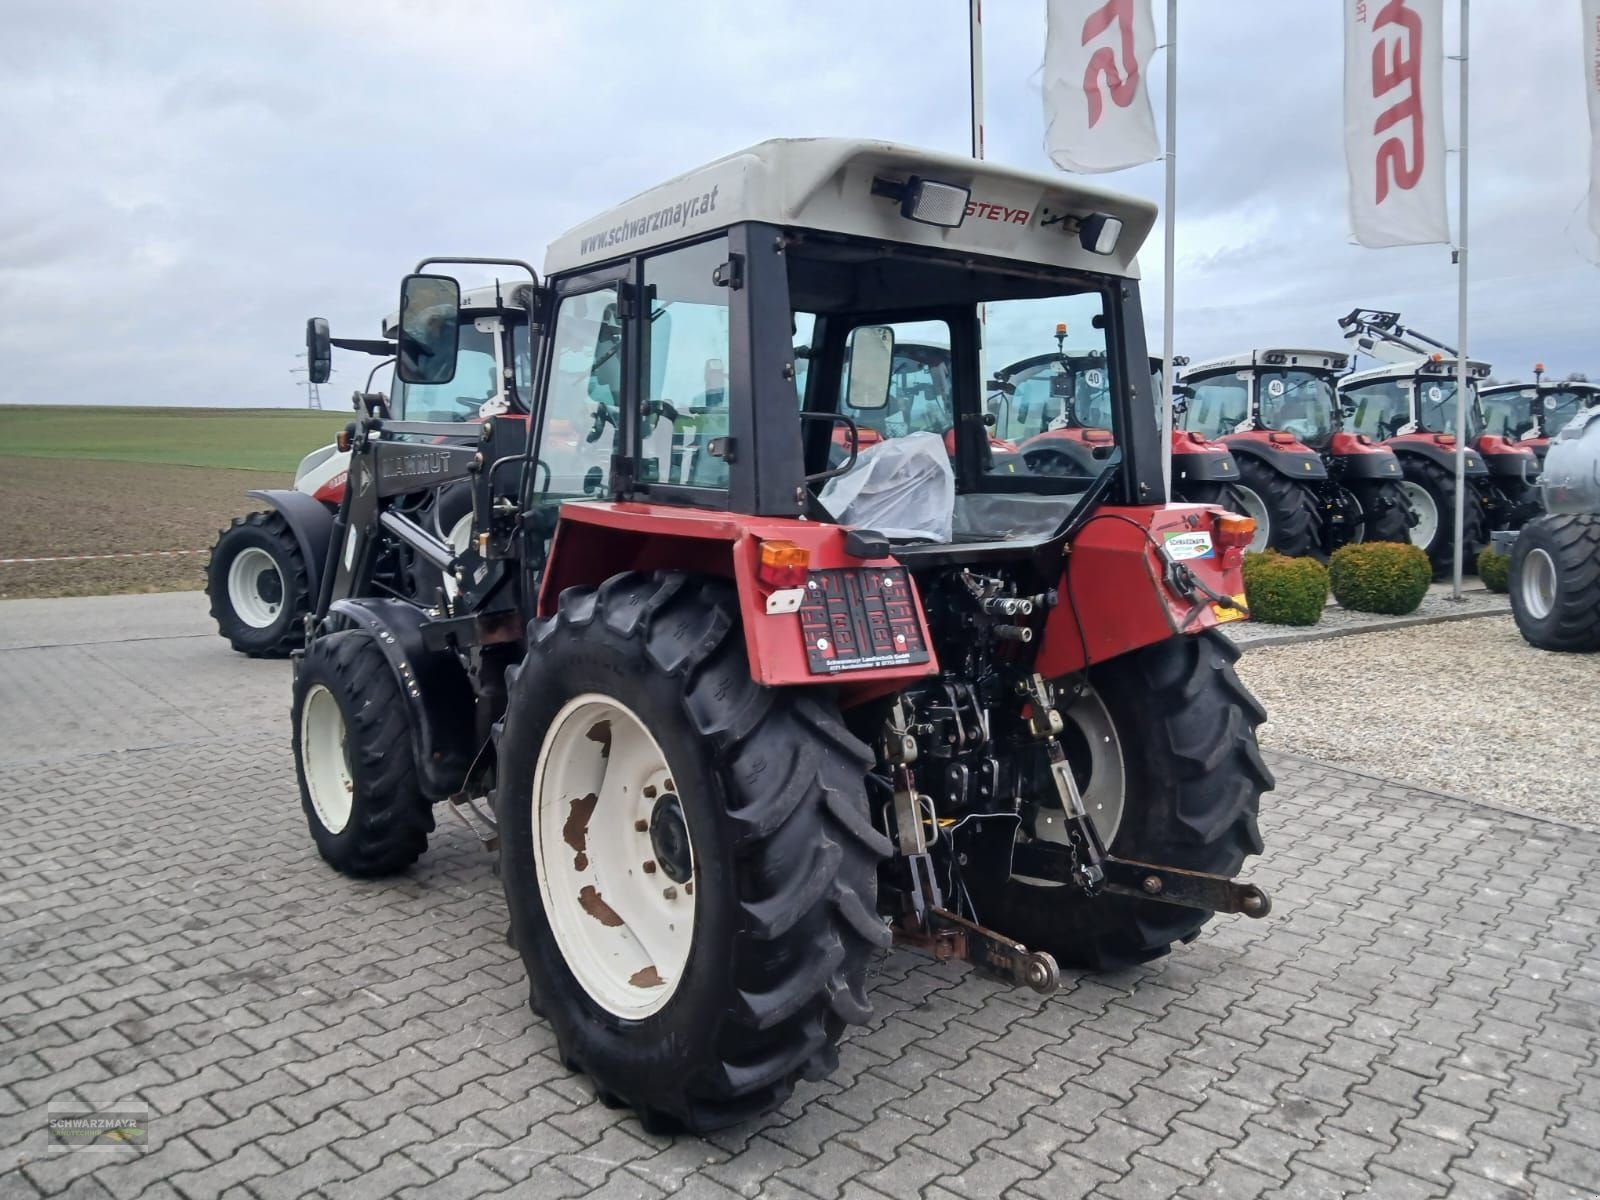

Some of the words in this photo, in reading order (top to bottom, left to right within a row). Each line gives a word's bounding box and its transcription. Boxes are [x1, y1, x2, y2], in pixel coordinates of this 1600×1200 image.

[580, 184, 719, 256] www.schwarzmayr.at
[965, 202, 1029, 225] STEYR
[1088, 373, 1100, 384] 40
[1271, 381, 1282, 392] 40
